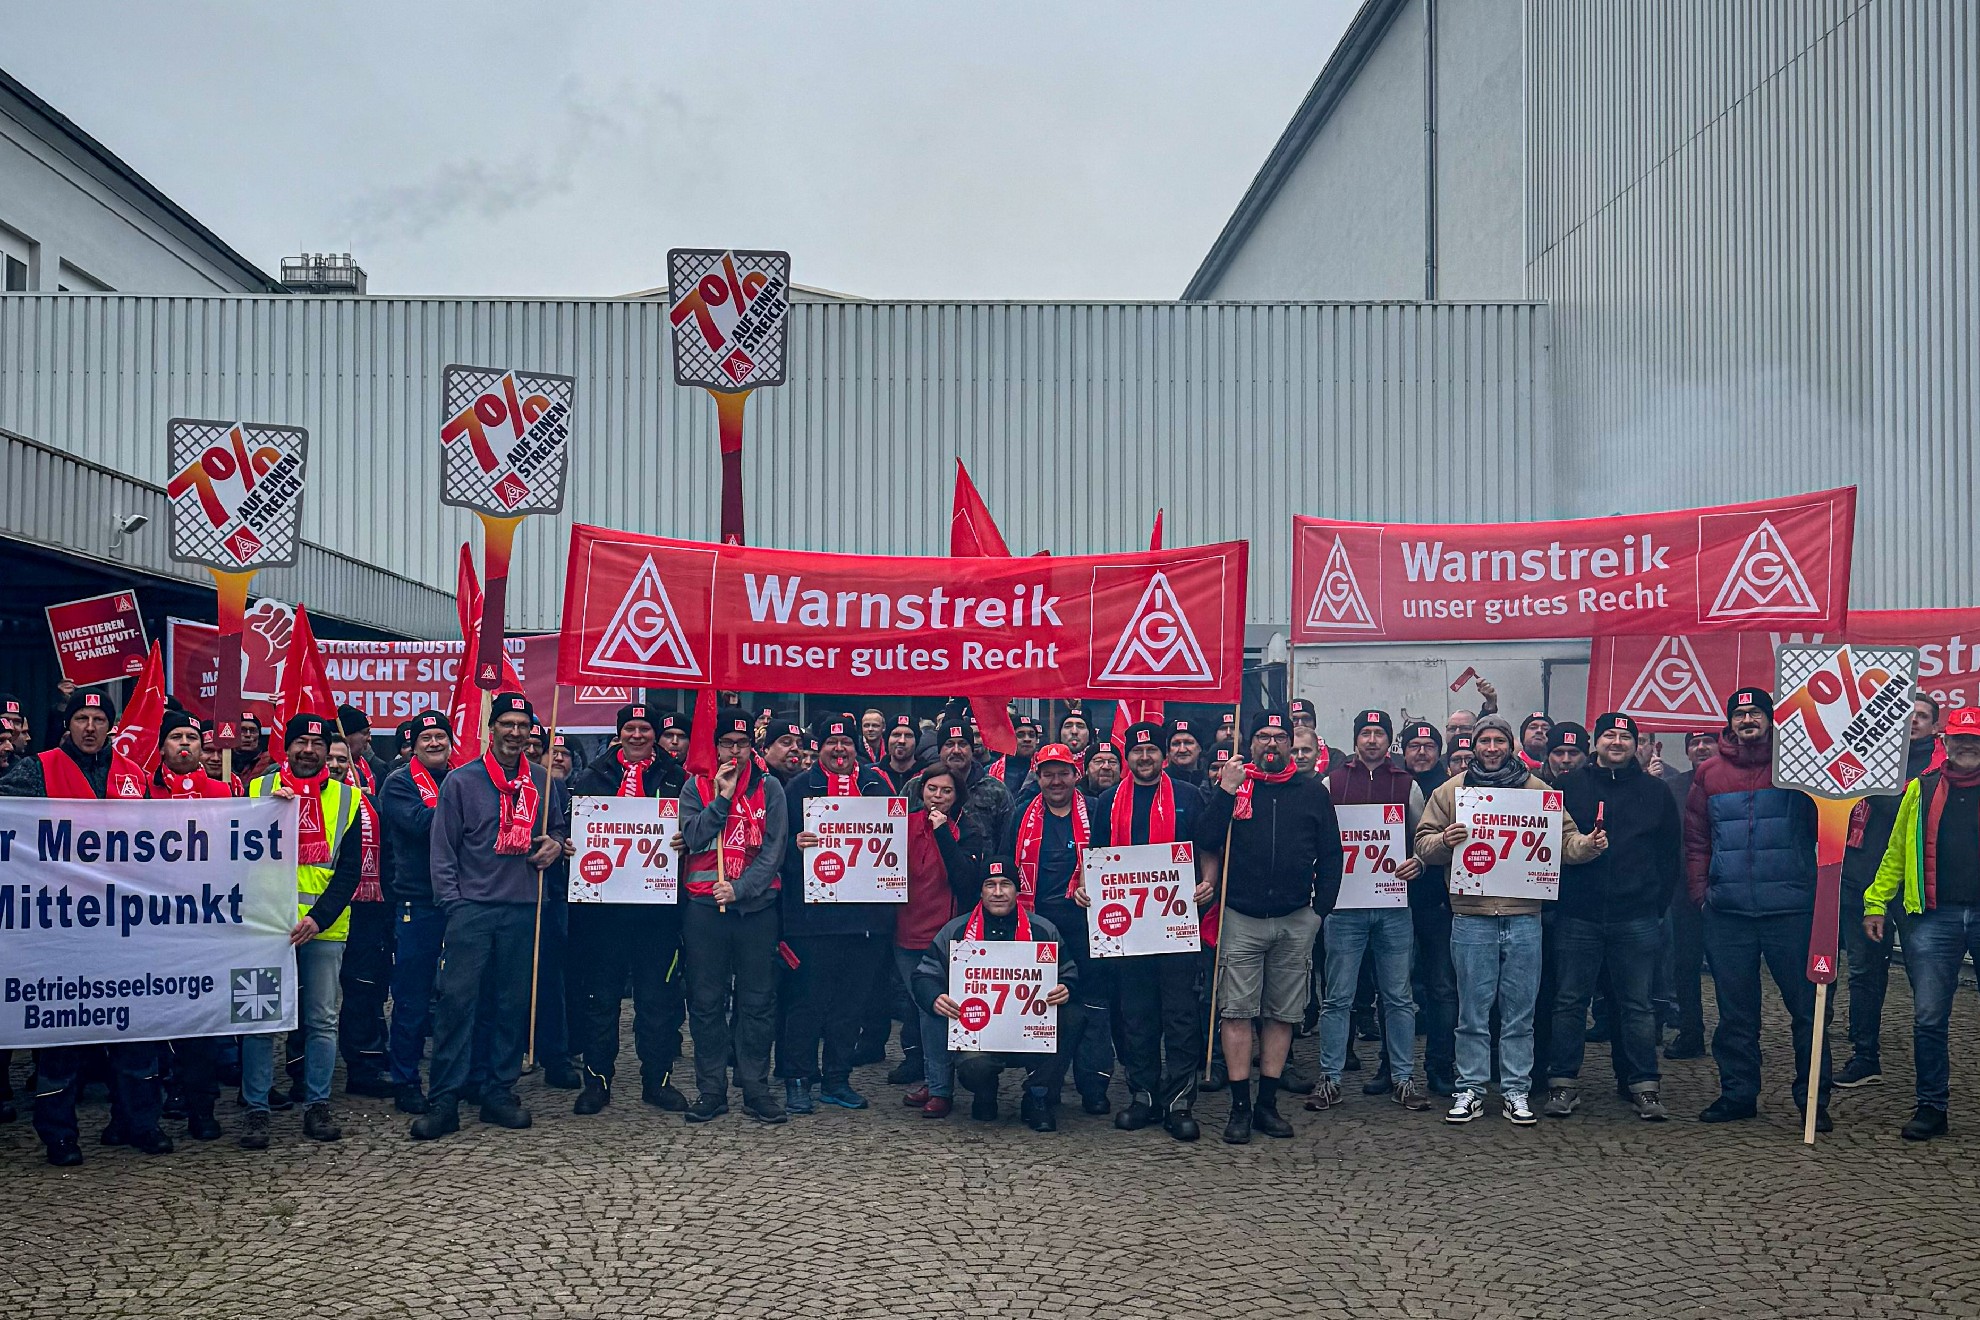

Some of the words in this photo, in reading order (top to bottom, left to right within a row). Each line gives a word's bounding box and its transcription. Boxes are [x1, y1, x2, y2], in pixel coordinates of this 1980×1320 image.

[731, 313, 755, 344] AUF
[749, 276, 784, 318] EINEN
[742, 297, 787, 353] STREICH
[506, 437, 531, 467] AUF
[528, 401, 568, 442] EINEN
[517, 423, 569, 479] STREICH
[237, 489, 265, 521] AUF
[258, 453, 300, 495] EINEN
[249, 475, 302, 532] STREICH
[1401, 534, 1670, 582] Warnstreik
[743, 573, 1063, 630] Warnstreik
[1402, 597, 1476, 618] unser
[1484, 594, 1568, 624] gutes
[1578, 582, 1669, 613] Recht
[57, 619, 125, 641] INVESTIEREN
[61, 637, 92, 653] STATT
[95, 628, 140, 646] KAPUTT-
[75, 643, 120, 661] SPAREN.
[317, 641, 390, 654] STARKES
[742, 642, 840, 669] unser
[850, 642, 949, 677] gutes
[962, 639, 1059, 670] Recht
[325, 658, 410, 681] AUCHT
[1841, 713, 1869, 746] AUF
[1864, 673, 1910, 719] EINEN
[1853, 696, 1912, 757] STREICH
[586, 822, 664, 835] GEMEINSAM
[818, 822, 894, 834] GEMEINSAM
[1471, 826, 1495, 840] FÜR
[1472, 813, 1548, 829] GEMEINSAM
[38, 819, 209, 862] Mensch
[230, 819, 283, 861] ist
[586, 834, 610, 848] FÜR
[818, 835, 841, 848] FÜR
[1341, 830, 1391, 841] EINSAM
[1100, 870, 1180, 886] GEMEINSAM
[1101, 887, 1126, 900] FÜR
[964, 967, 1042, 981] GEMEINSAM
[5, 973, 214, 1003] Betriebsseelsorge
[964, 981, 988, 994] FÜR
[24, 1003, 130, 1031] Bamberg
